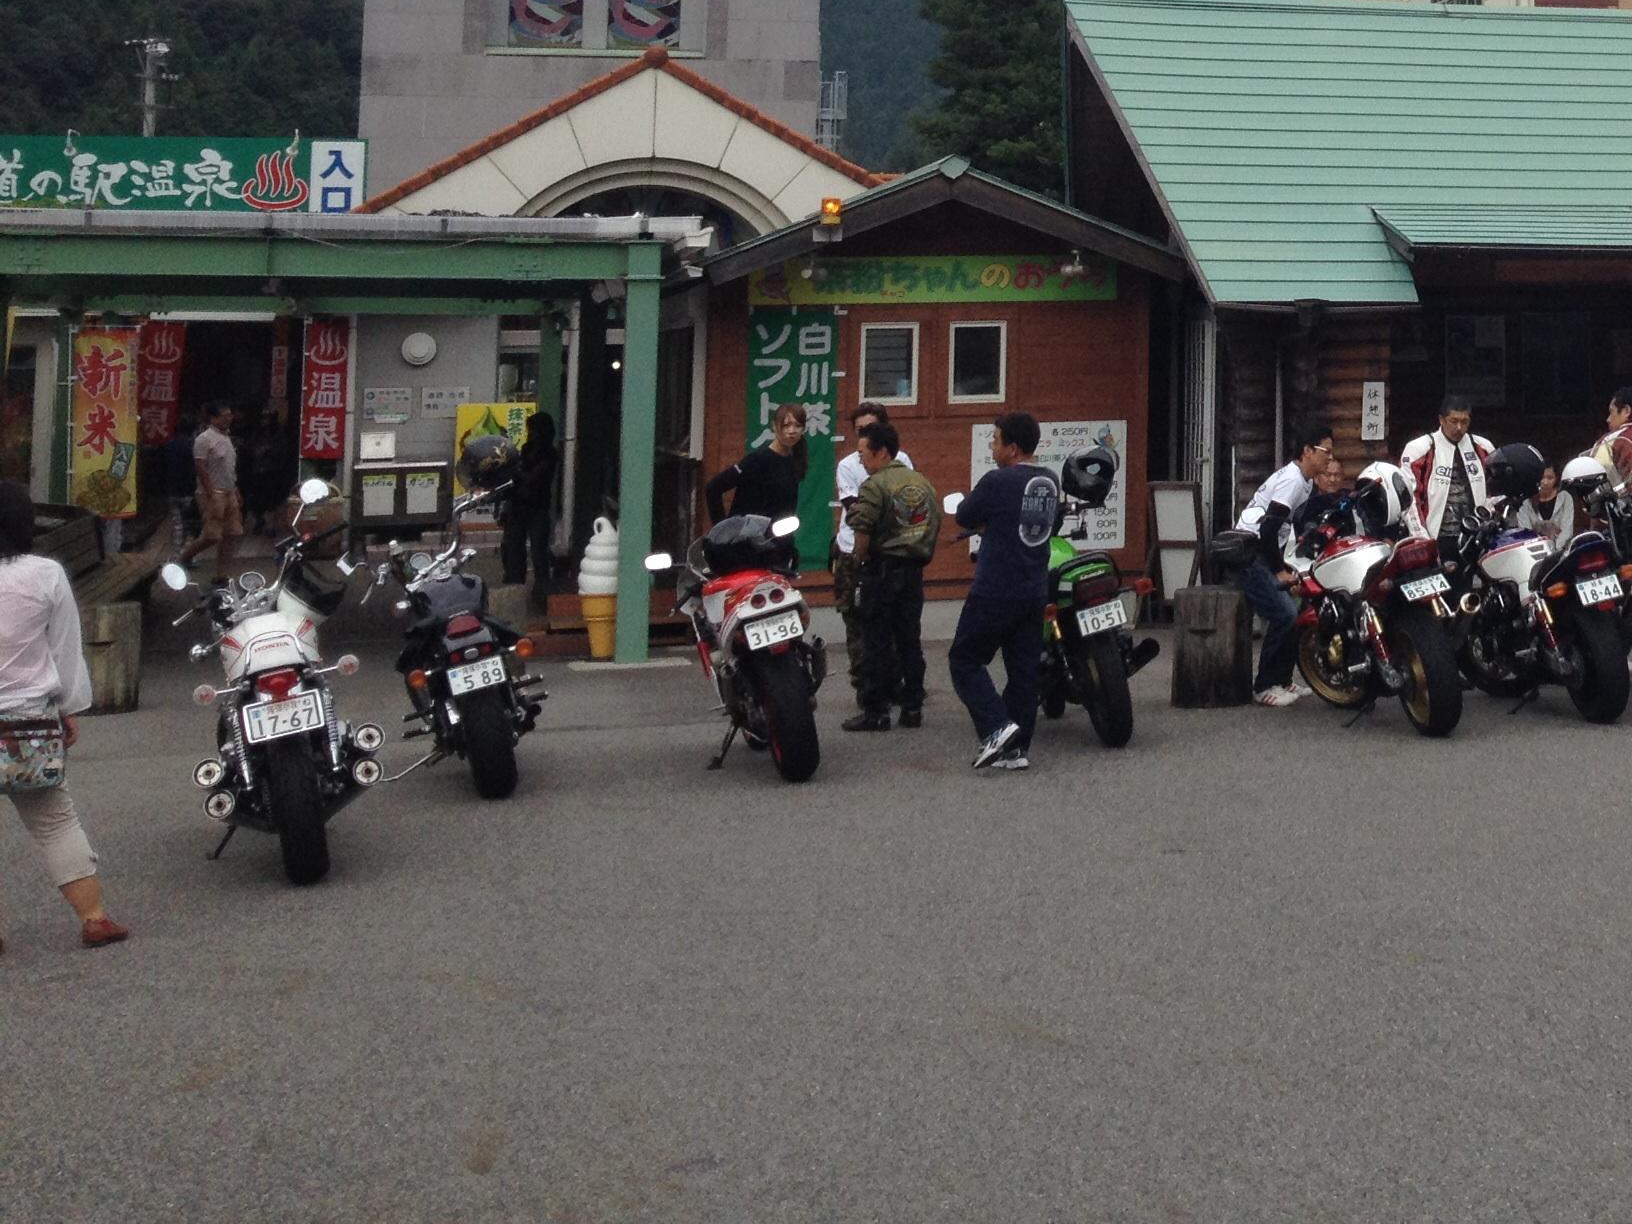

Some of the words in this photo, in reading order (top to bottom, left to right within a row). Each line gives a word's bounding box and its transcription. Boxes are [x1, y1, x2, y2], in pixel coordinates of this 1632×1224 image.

[320, 150, 355, 213] 入口
[77, 345, 127, 456] 新米
[795, 322, 832, 436] 白川茶
[304, 372, 343, 451] 温泉
[1583, 583, 1620, 603] 18-44
[752, 621, 799, 646] 31-96
[1083, 610, 1123, 634] 10-51
[258, 707, 313, 736] 17-67
